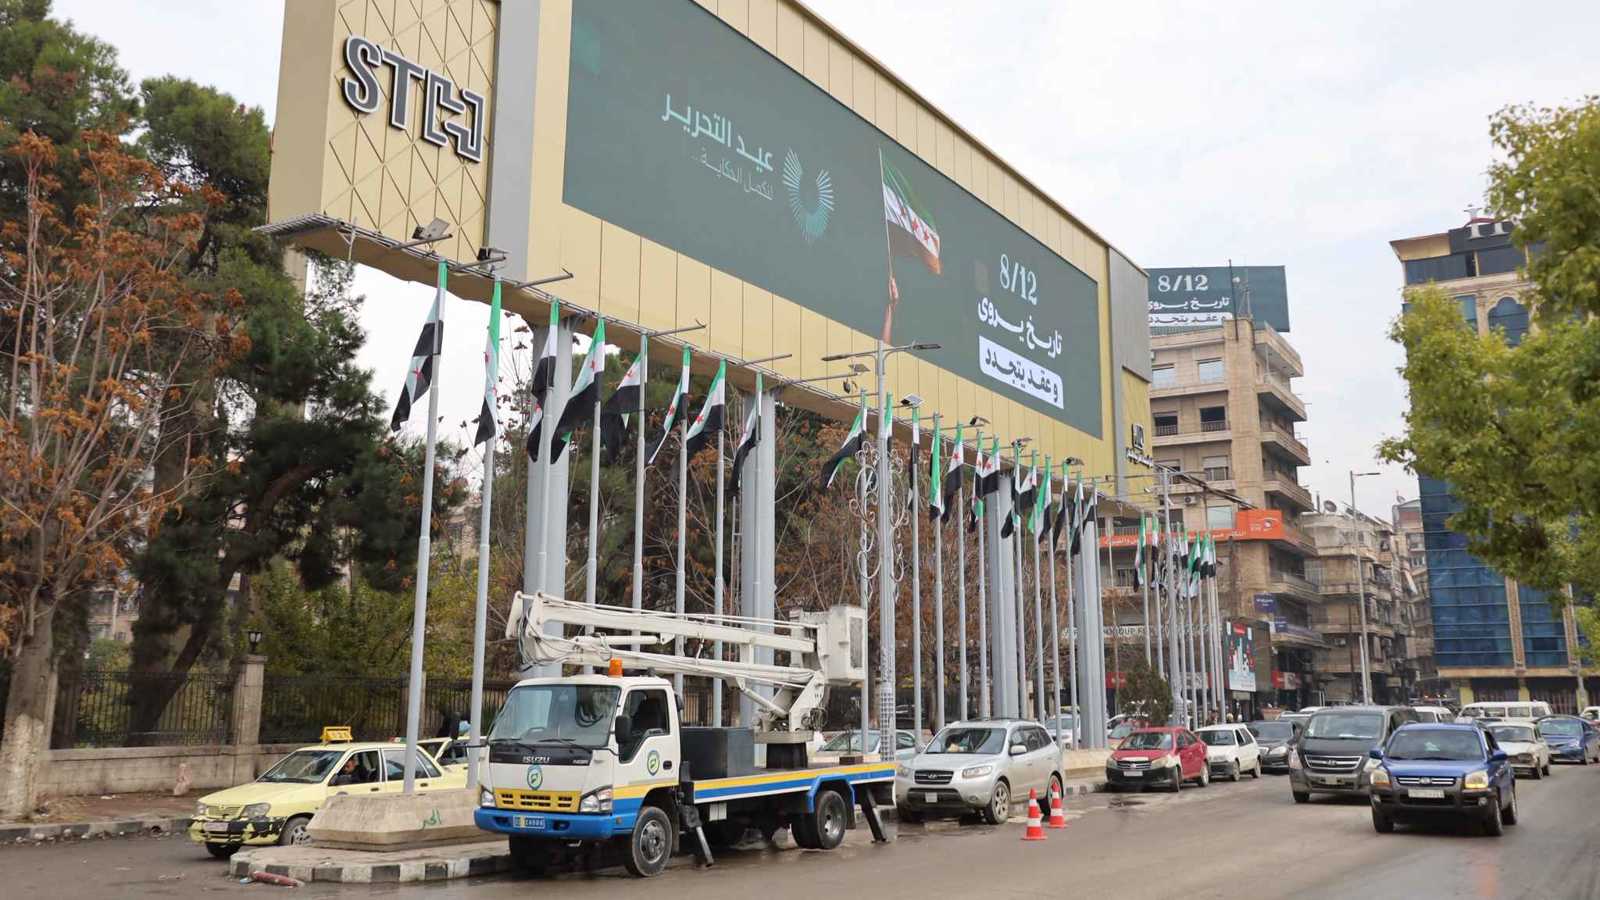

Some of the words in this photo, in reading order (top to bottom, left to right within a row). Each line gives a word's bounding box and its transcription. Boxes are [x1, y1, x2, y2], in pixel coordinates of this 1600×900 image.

[662, 94, 732, 148] التحرير
[736, 134, 774, 173] عيد
[1000, 253, 1038, 306] 8/12
[1158, 274, 1209, 293] 8/12
[1190, 296, 1230, 310] تاريخ
[1026, 315, 1063, 359] تاريخ
[985, 348, 1026, 389] يتجدد
